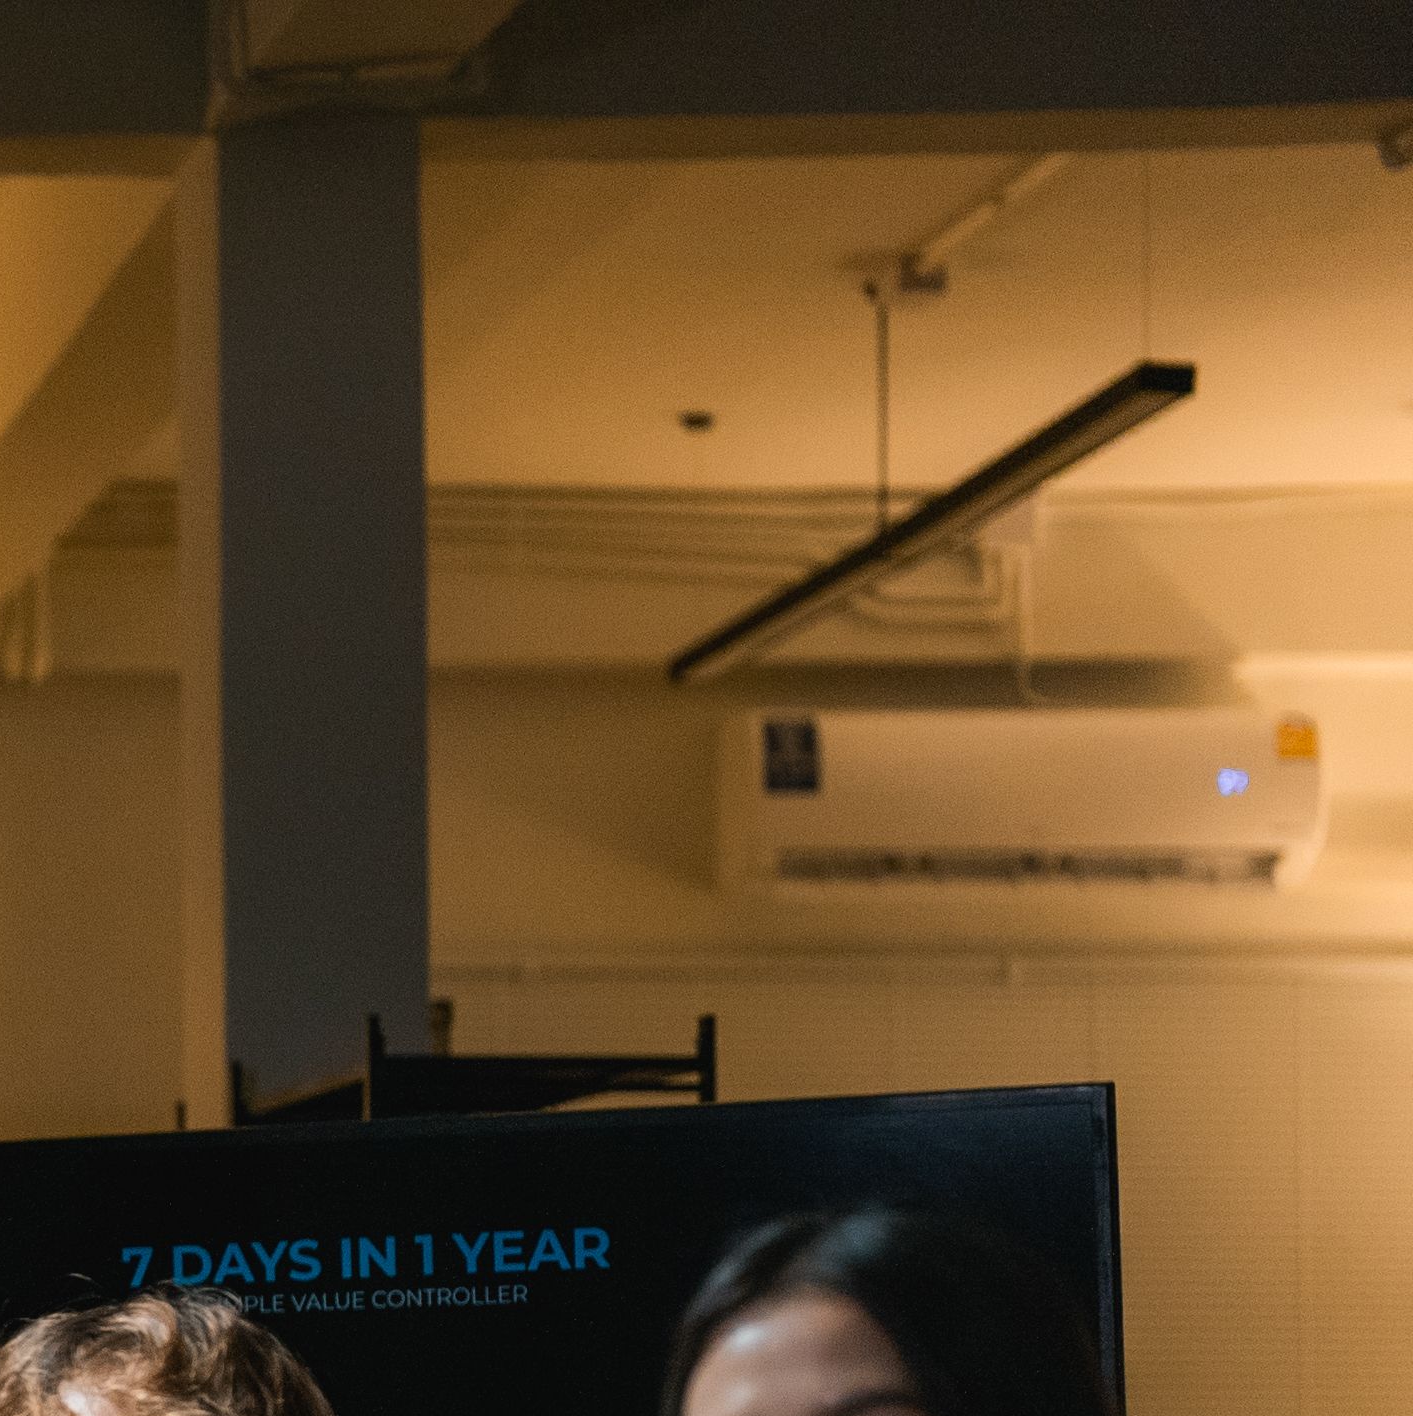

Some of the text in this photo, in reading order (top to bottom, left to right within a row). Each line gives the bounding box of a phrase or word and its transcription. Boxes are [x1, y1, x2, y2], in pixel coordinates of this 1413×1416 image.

[121, 1226, 611, 1288] 7 DAYS IN 1 YEAR
[290, 1290, 366, 1313] VALUE
[372, 1284, 529, 1308] CONTROLLER
